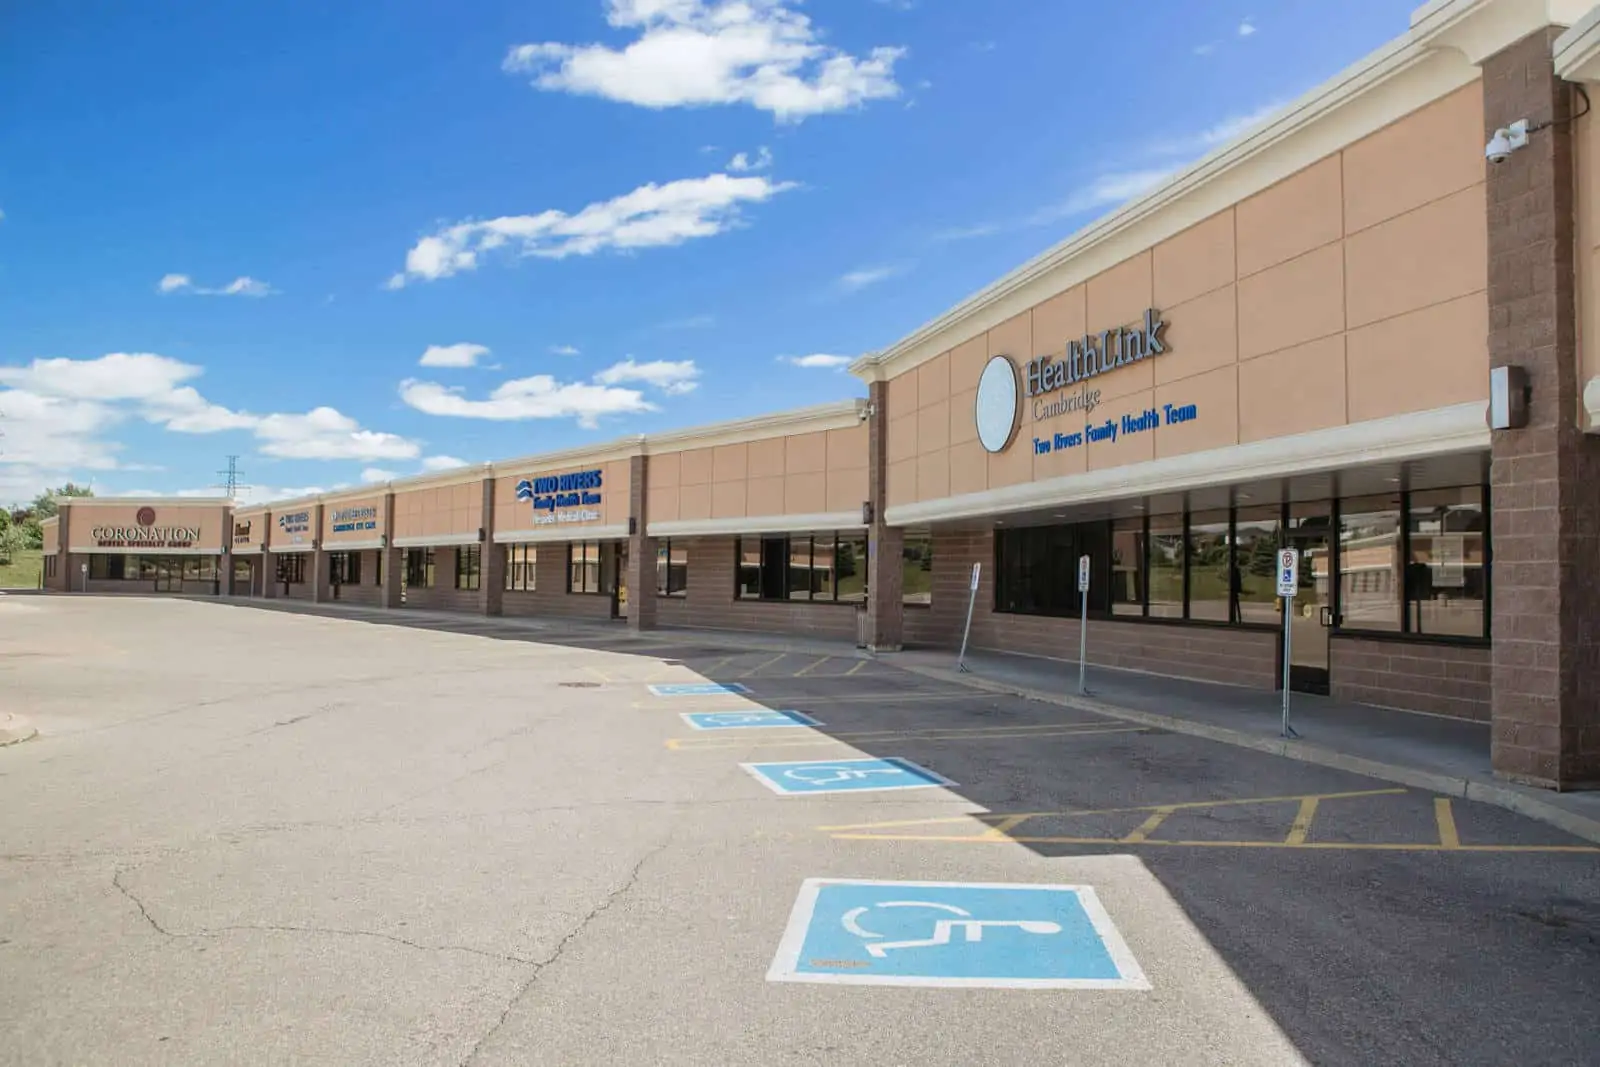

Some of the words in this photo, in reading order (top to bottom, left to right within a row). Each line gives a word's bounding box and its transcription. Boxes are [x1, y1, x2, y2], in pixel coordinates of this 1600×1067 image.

[1025, 308, 1166, 397] HealthLink
[1033, 382, 1101, 421] Cambridge
[1033, 438, 1051, 455] Two
[1054, 430, 1082, 450] Rivers
[1085, 421, 1118, 443] Family
[1122, 409, 1160, 434] Health
[1163, 403, 1197, 425] Team
[533, 477, 558, 494] TWO
[559, 470, 602, 491] RIVERS
[91, 527, 200, 541] CORONATION
